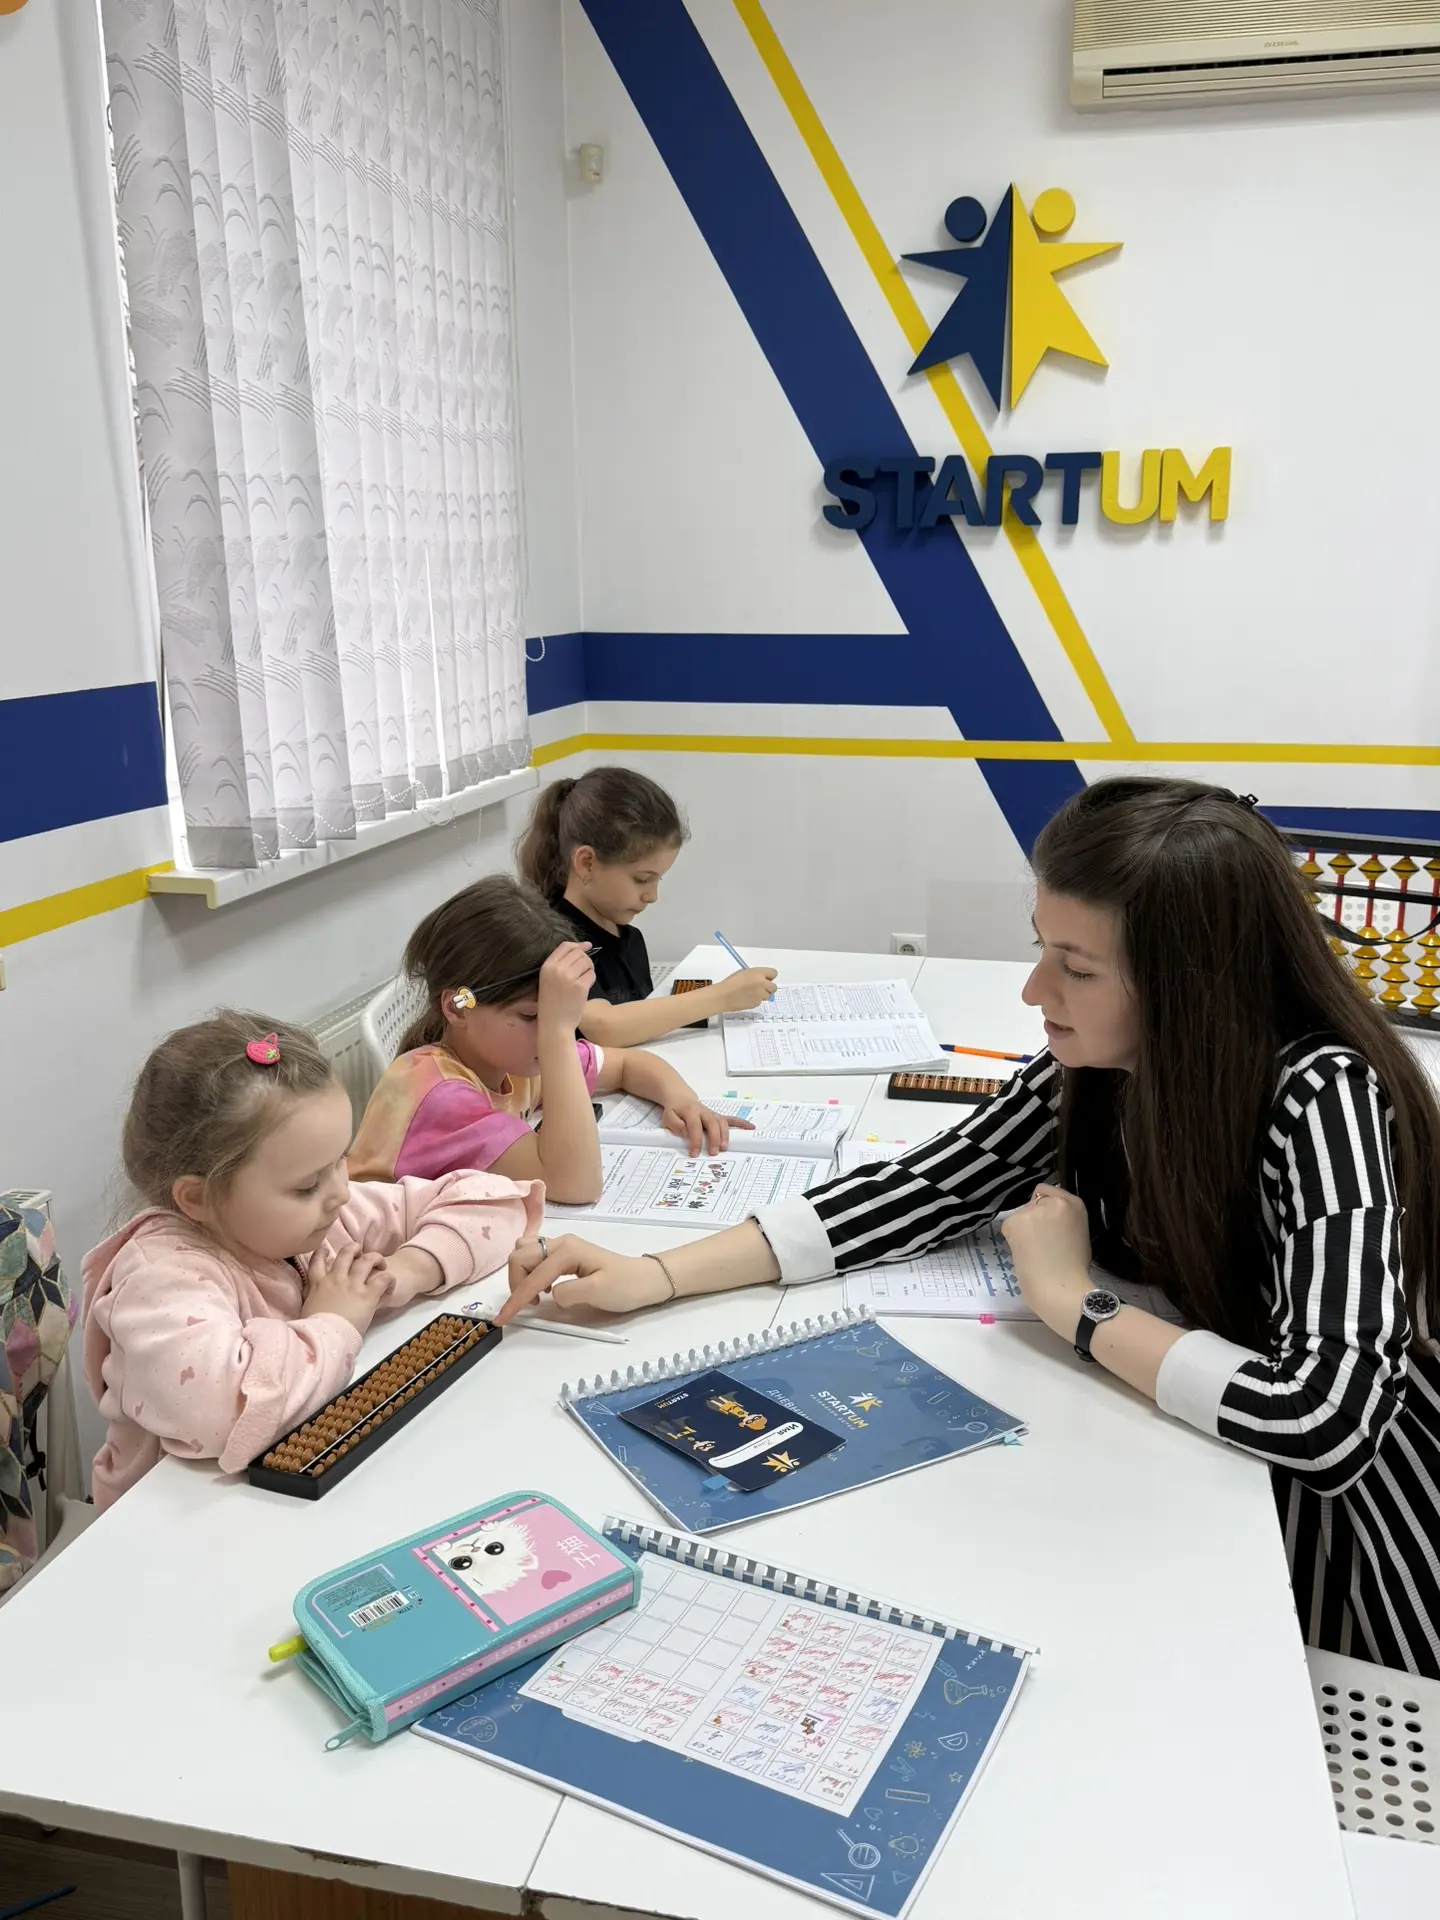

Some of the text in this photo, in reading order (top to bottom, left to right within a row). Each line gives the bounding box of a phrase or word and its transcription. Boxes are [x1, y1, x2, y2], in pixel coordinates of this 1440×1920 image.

[822, 446, 1232, 530] STARTUM
[656, 1392, 689, 1409] STARTUM
[766, 1389, 812, 1421] ДНЕВНИ
[818, 1390, 869, 1429] STARTUM
